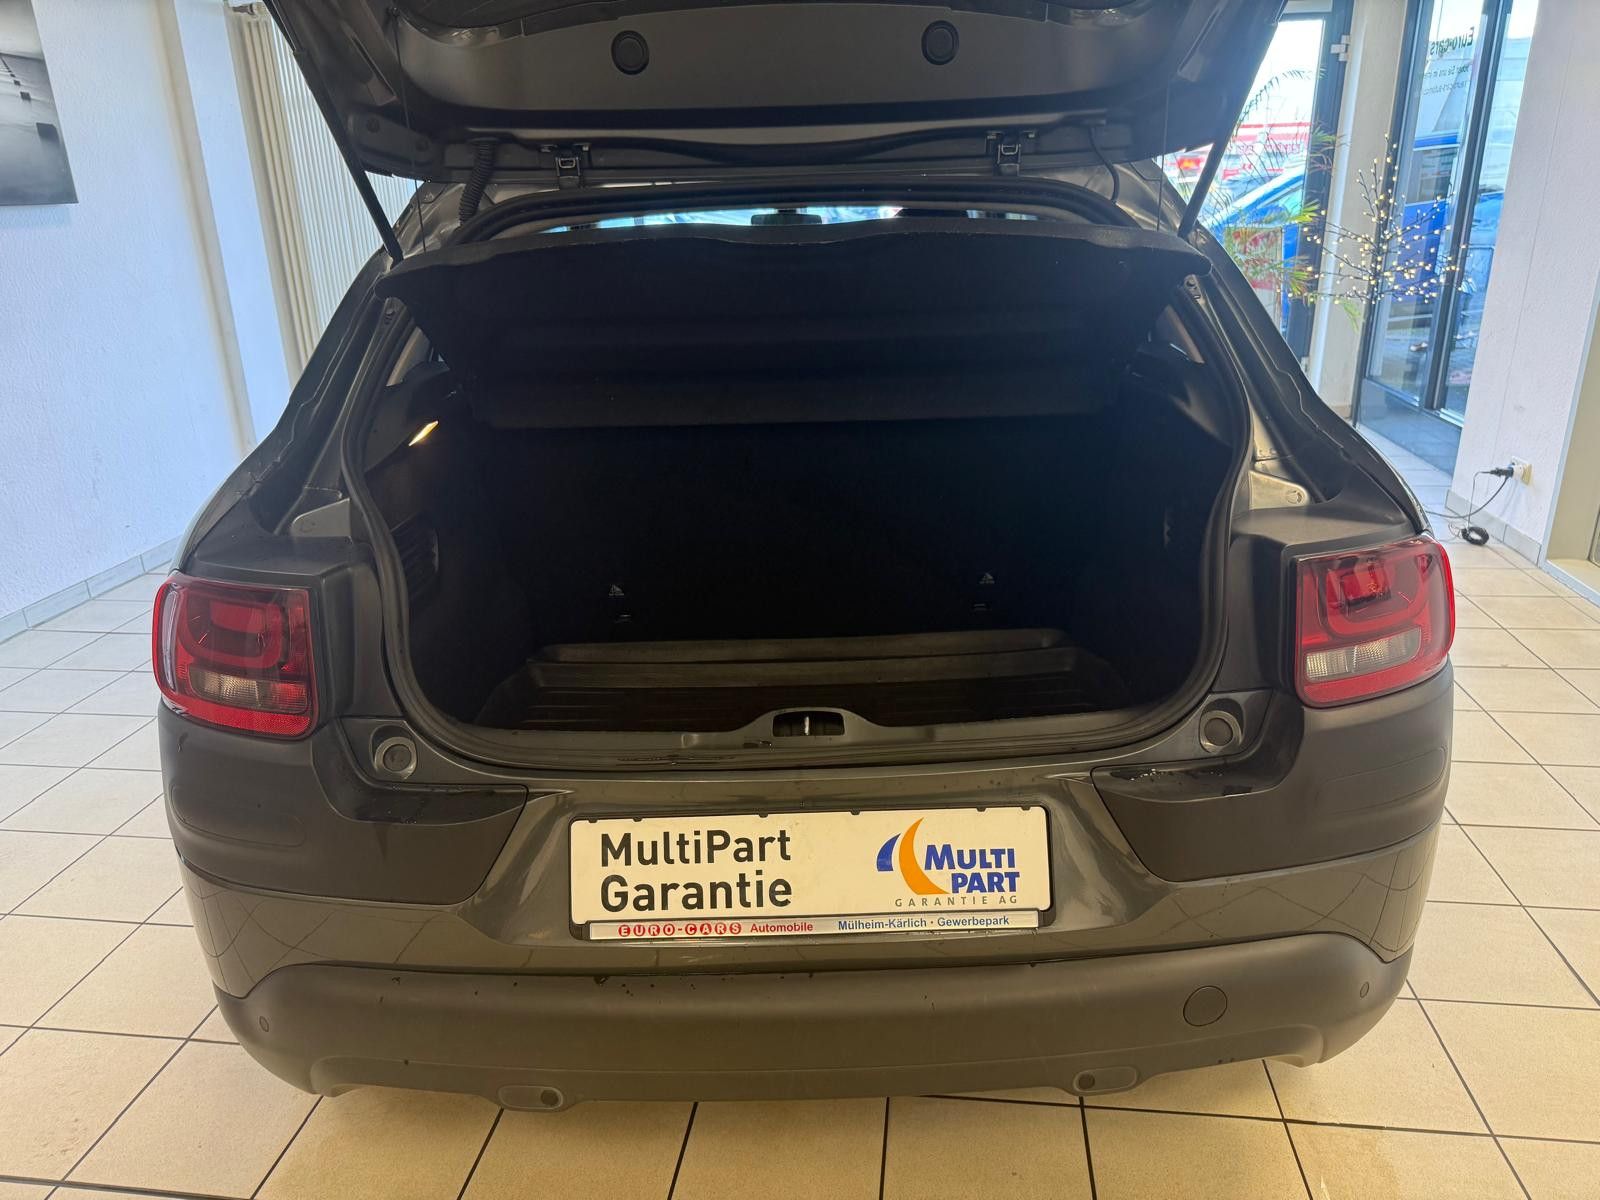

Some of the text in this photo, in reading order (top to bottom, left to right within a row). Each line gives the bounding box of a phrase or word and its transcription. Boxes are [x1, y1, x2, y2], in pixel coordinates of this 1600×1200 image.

[601, 829, 791, 867] MultiPart
[924, 844, 1016, 870] MULTI
[601, 870, 792, 913] Garantie
[951, 871, 1020, 894] PART
[895, 895, 1018, 907] GARANTIE AG
[618, 915, 1009, 937] EURO-CARS Automobile Mülheim-Kärlich Gewerbepark
